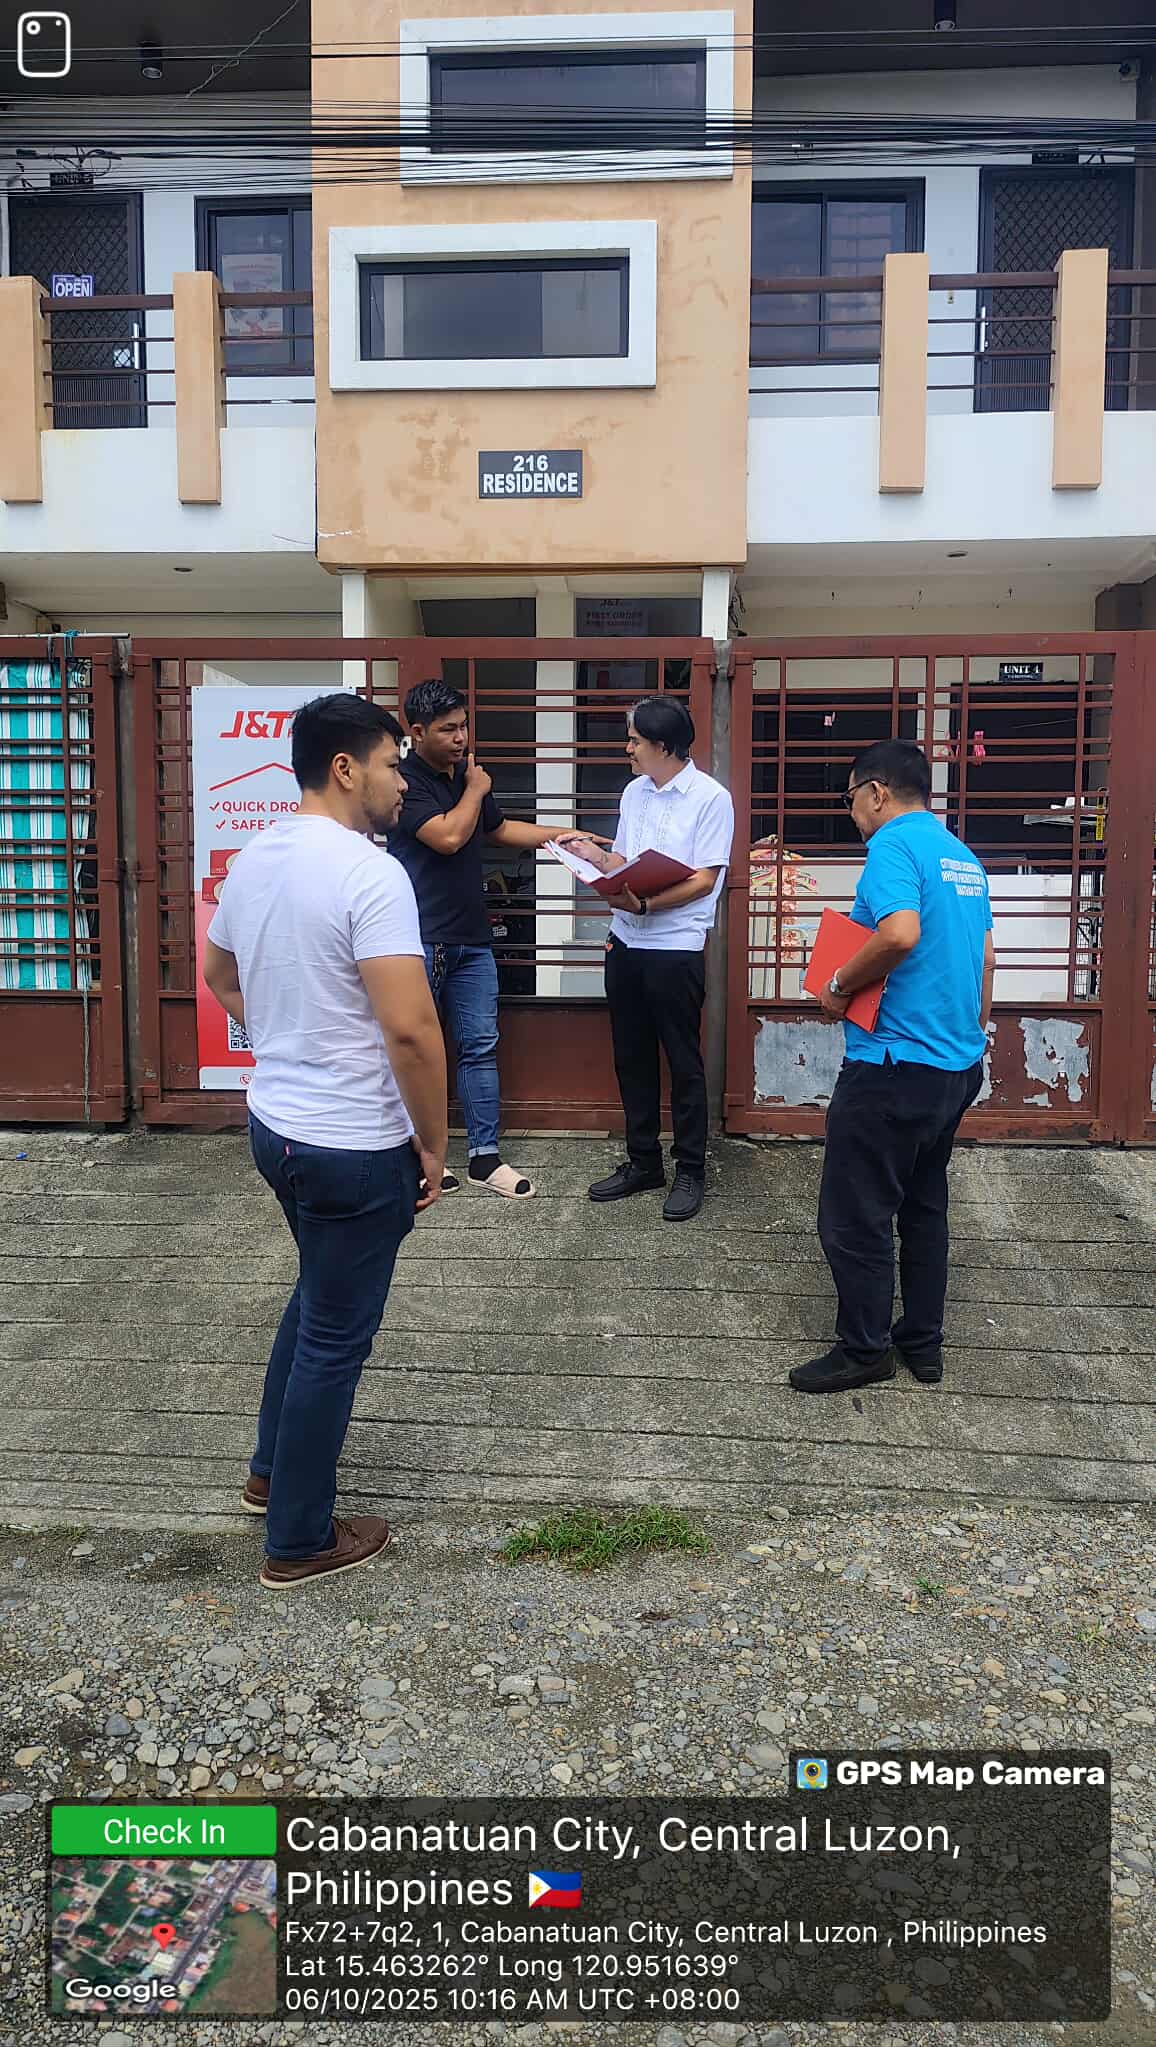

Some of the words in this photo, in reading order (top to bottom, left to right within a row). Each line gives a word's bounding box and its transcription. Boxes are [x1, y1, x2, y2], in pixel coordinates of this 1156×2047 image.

[55, 282, 90, 297] OPEN
[513, 455, 549, 472] 216
[483, 472, 578, 493] RESIDENCE
[1004, 665, 1030, 673] UNIT
[219, 711, 290, 738] J&T
[222, 801, 266, 814] QUICK
[231, 819, 265, 830] SAFE
